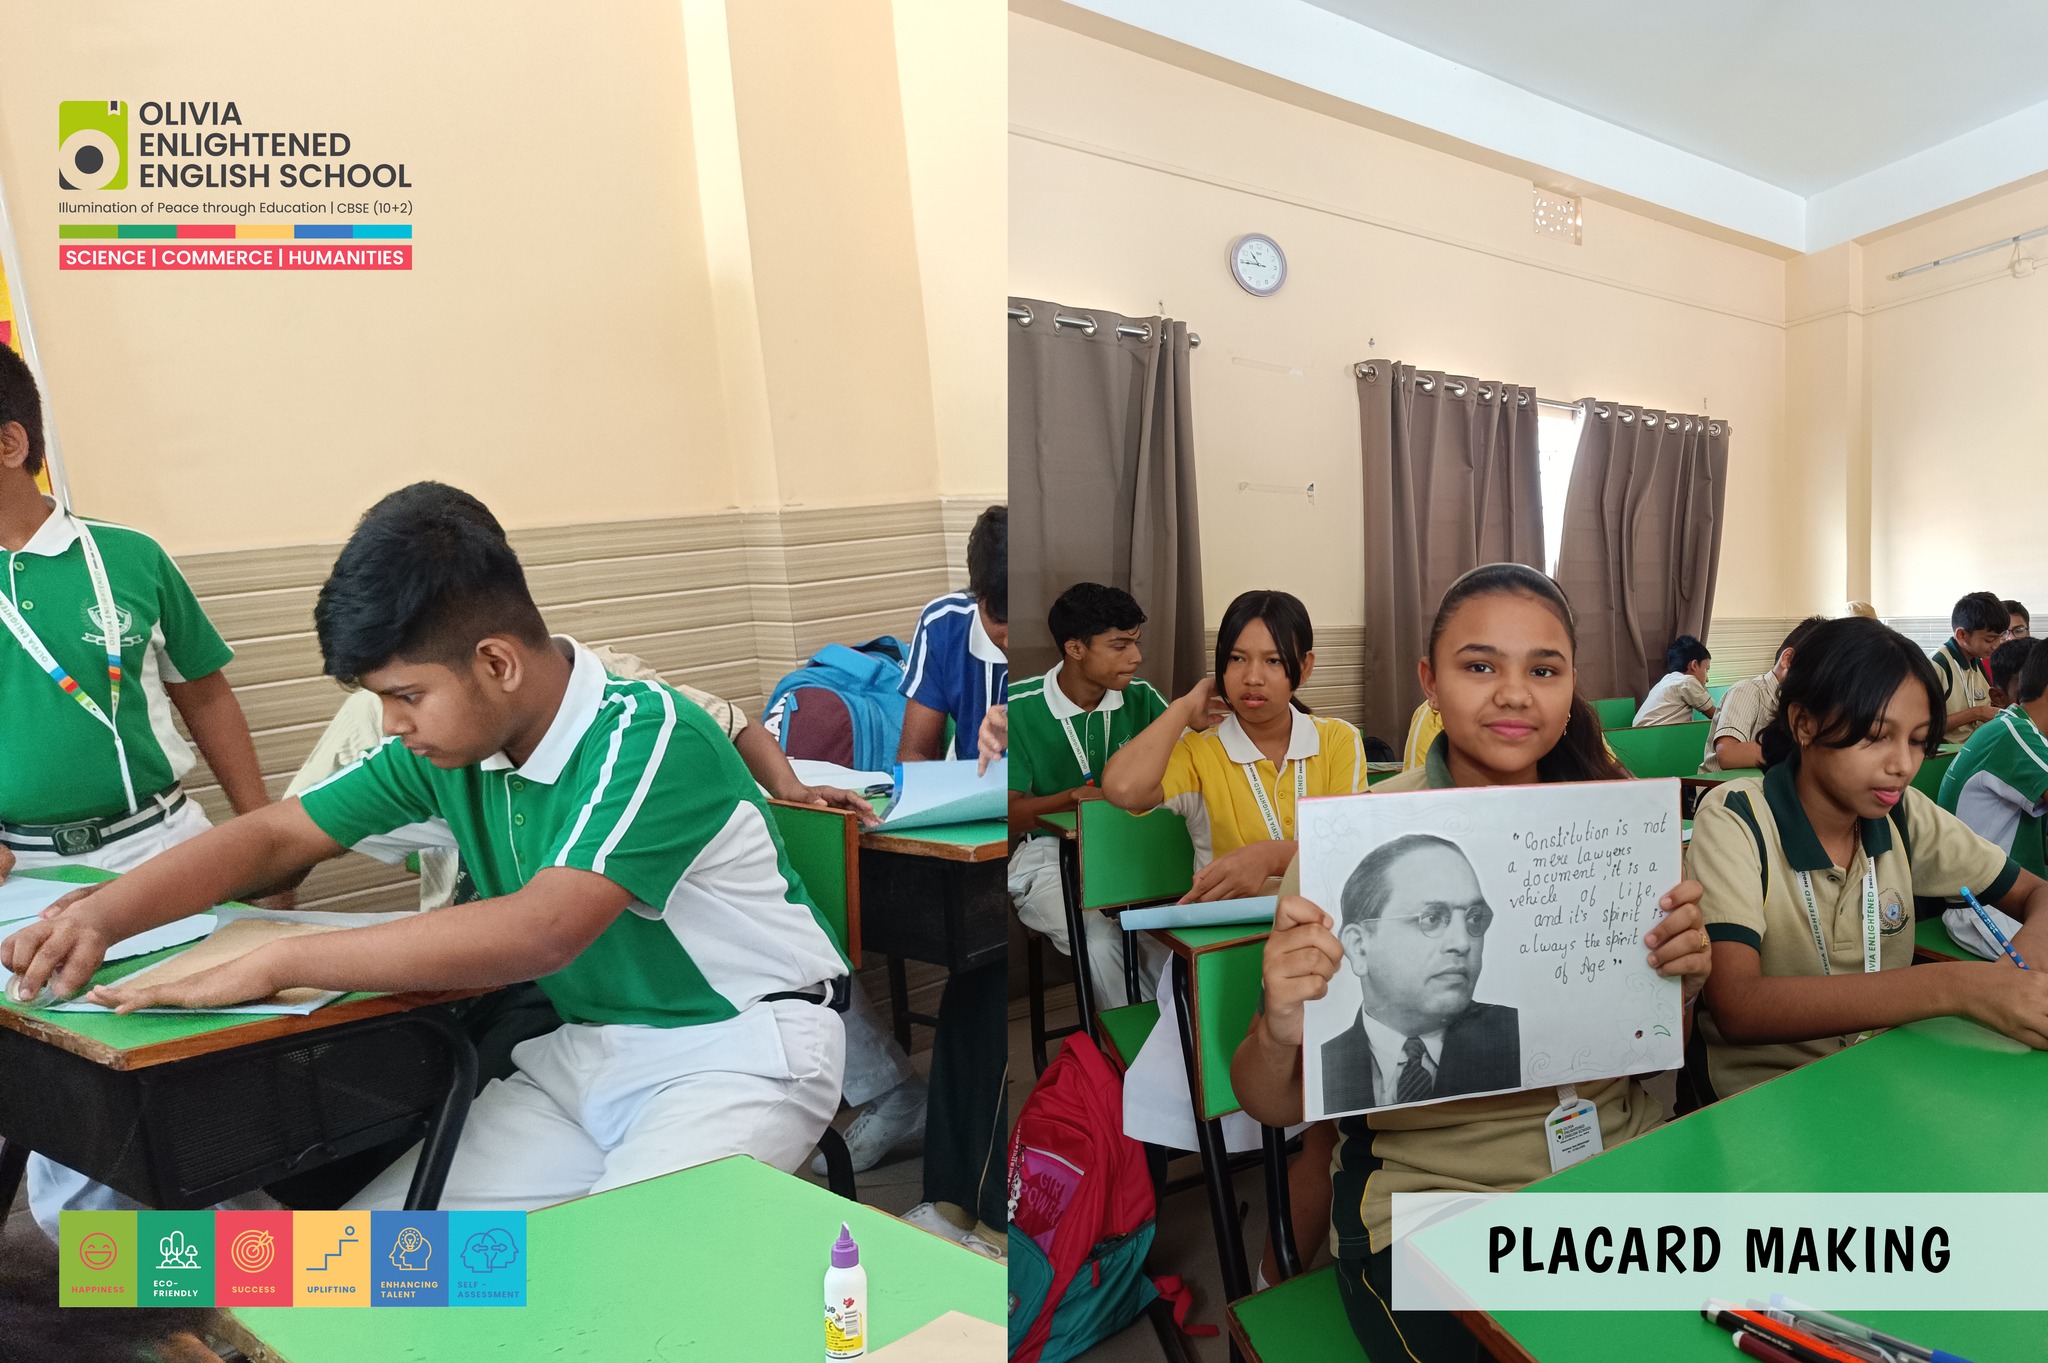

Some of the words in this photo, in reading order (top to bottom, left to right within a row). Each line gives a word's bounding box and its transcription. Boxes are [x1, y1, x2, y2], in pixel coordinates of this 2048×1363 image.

[0, 598, 30, 638] ENLIGHTEN
[28, 638, 48, 663] OLIVIA
[1254, 782, 1273, 822] ENLIGHTENED
[1270, 821, 1280, 840] OLIVIA
[1616, 819, 1628, 836] is
[1644, 812, 1667, 834] not
[1508, 861, 1517, 873] a
[1533, 853, 1568, 868] mere
[1578, 846, 1631, 867] lawyers
[1611, 860, 1622, 877] it
[1628, 862, 1639, 875] is
[1649, 861, 1658, 872] a
[1510, 884, 1557, 909] vehicle
[1581, 885, 1596, 907] of
[1534, 905, 1563, 927] and
[1569, 905, 1587, 924] it's
[1603, 901, 1640, 930] spirit
[1652, 908, 1663, 920] is
[1805, 890, 1823, 951] ENLIGHTENED
[1868, 891, 1876, 952] ENLIGHTENED
[1520, 933, 1576, 959] always
[1585, 932, 1600, 948] the
[1606, 928, 1638, 952] spirit
[1555, 962, 1568, 985] of
[1822, 953, 1830, 975] LIVIA
